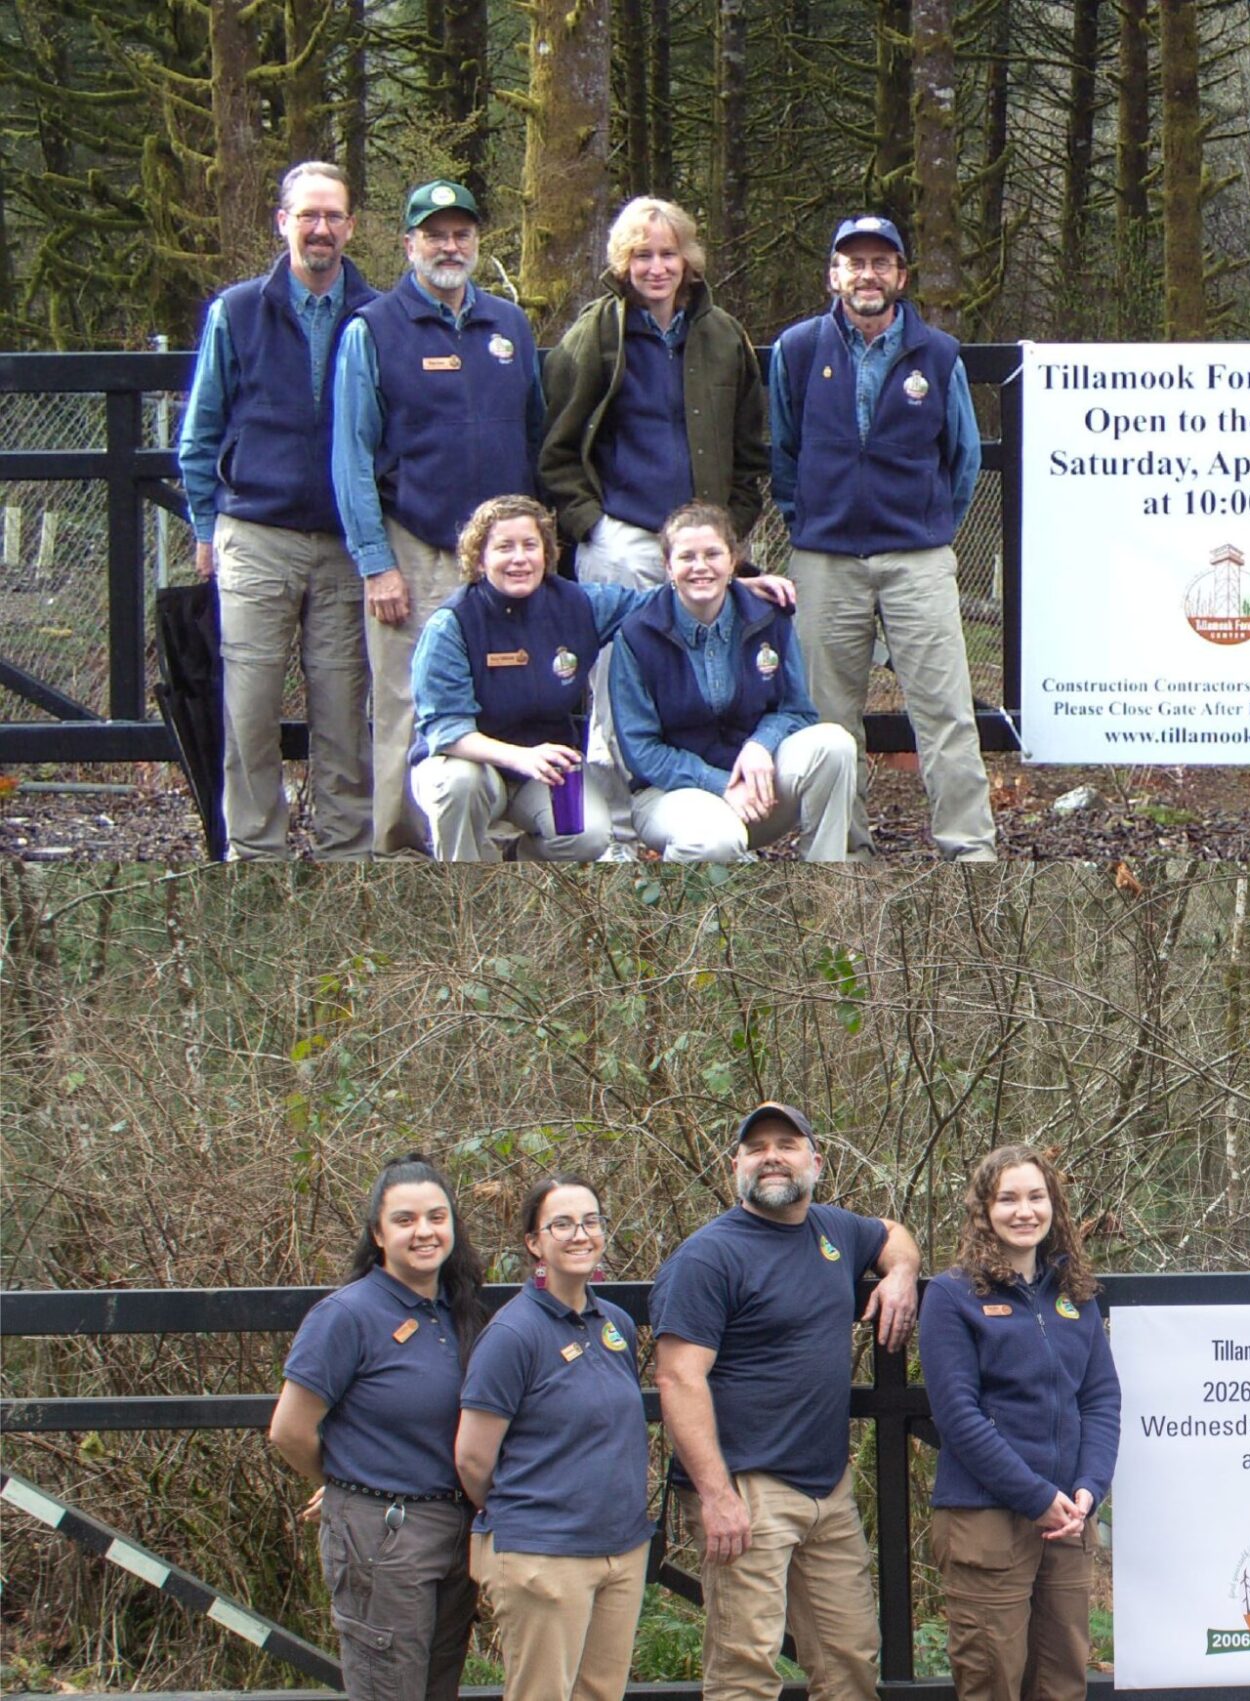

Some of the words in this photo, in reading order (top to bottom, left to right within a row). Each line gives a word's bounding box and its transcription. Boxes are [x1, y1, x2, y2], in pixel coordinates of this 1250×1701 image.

[1038, 364, 1195, 390] Tillamook
[1084, 407, 1166, 440] Open
[1178, 410, 1207, 433] to
[1050, 450, 1199, 482] Saturday,
[1143, 493, 1169, 515] at
[1195, 619, 1233, 632] Tillamook
[1041, 678, 1148, 693] Construction
[1154, 678, 1250, 693] Contractors
[1053, 701, 1104, 716] Please
[1108, 701, 1153, 716] Close
[1158, 702, 1196, 716] Gate
[1201, 702, 1243, 716] After
[1212, 1633, 1250, 1648] 2006
